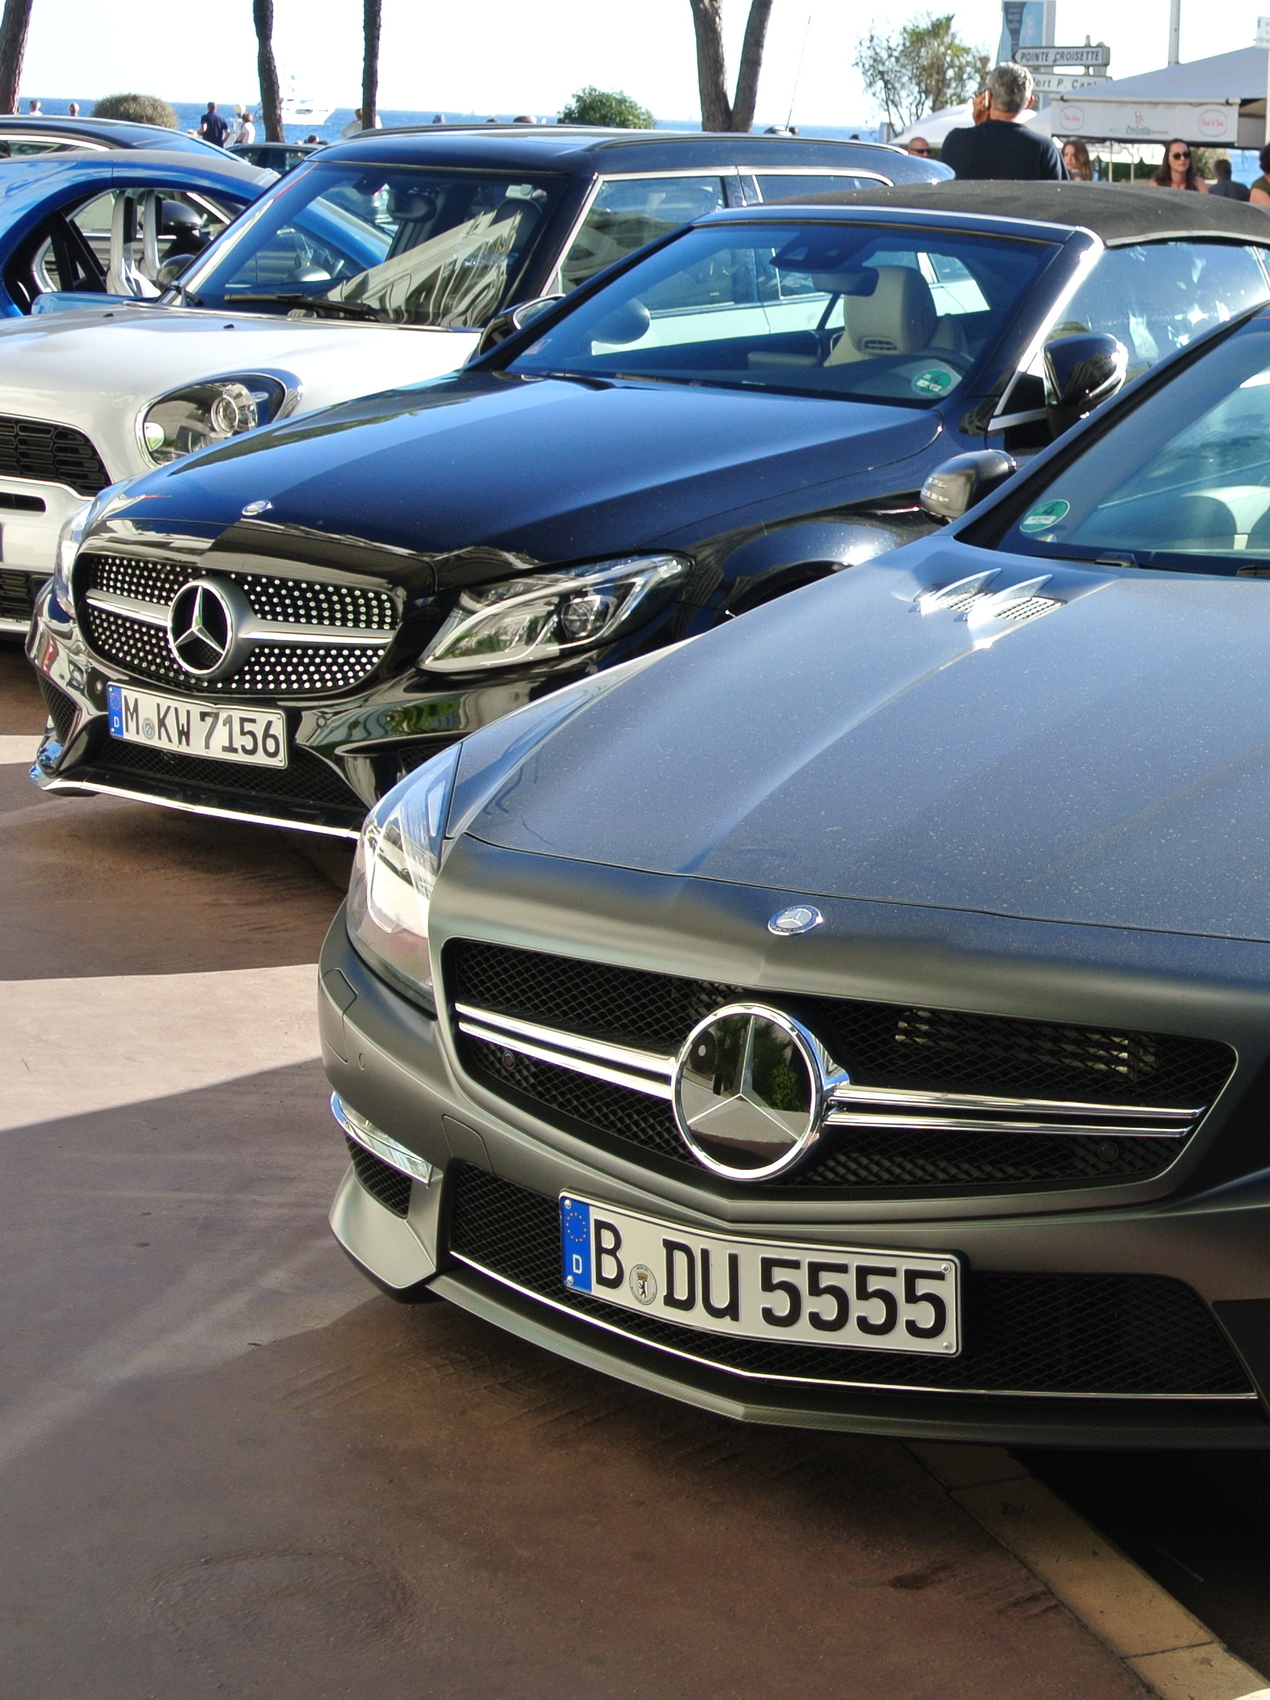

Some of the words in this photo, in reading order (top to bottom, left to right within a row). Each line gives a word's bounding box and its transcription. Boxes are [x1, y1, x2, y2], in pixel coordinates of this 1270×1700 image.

[1020, 51, 1049, 62] POINTE
[1054, 50, 1100, 62] CROISETTE
[113, 716, 120, 728] D
[123, 695, 140, 735] M
[156, 702, 191, 747] KW
[200, 711, 281, 758] 7156
[572, 1253, 583, 1275] D
[594, 1218, 625, 1290] B
[662, 1238, 740, 1322] DU
[760, 1256, 947, 1339] 5555
